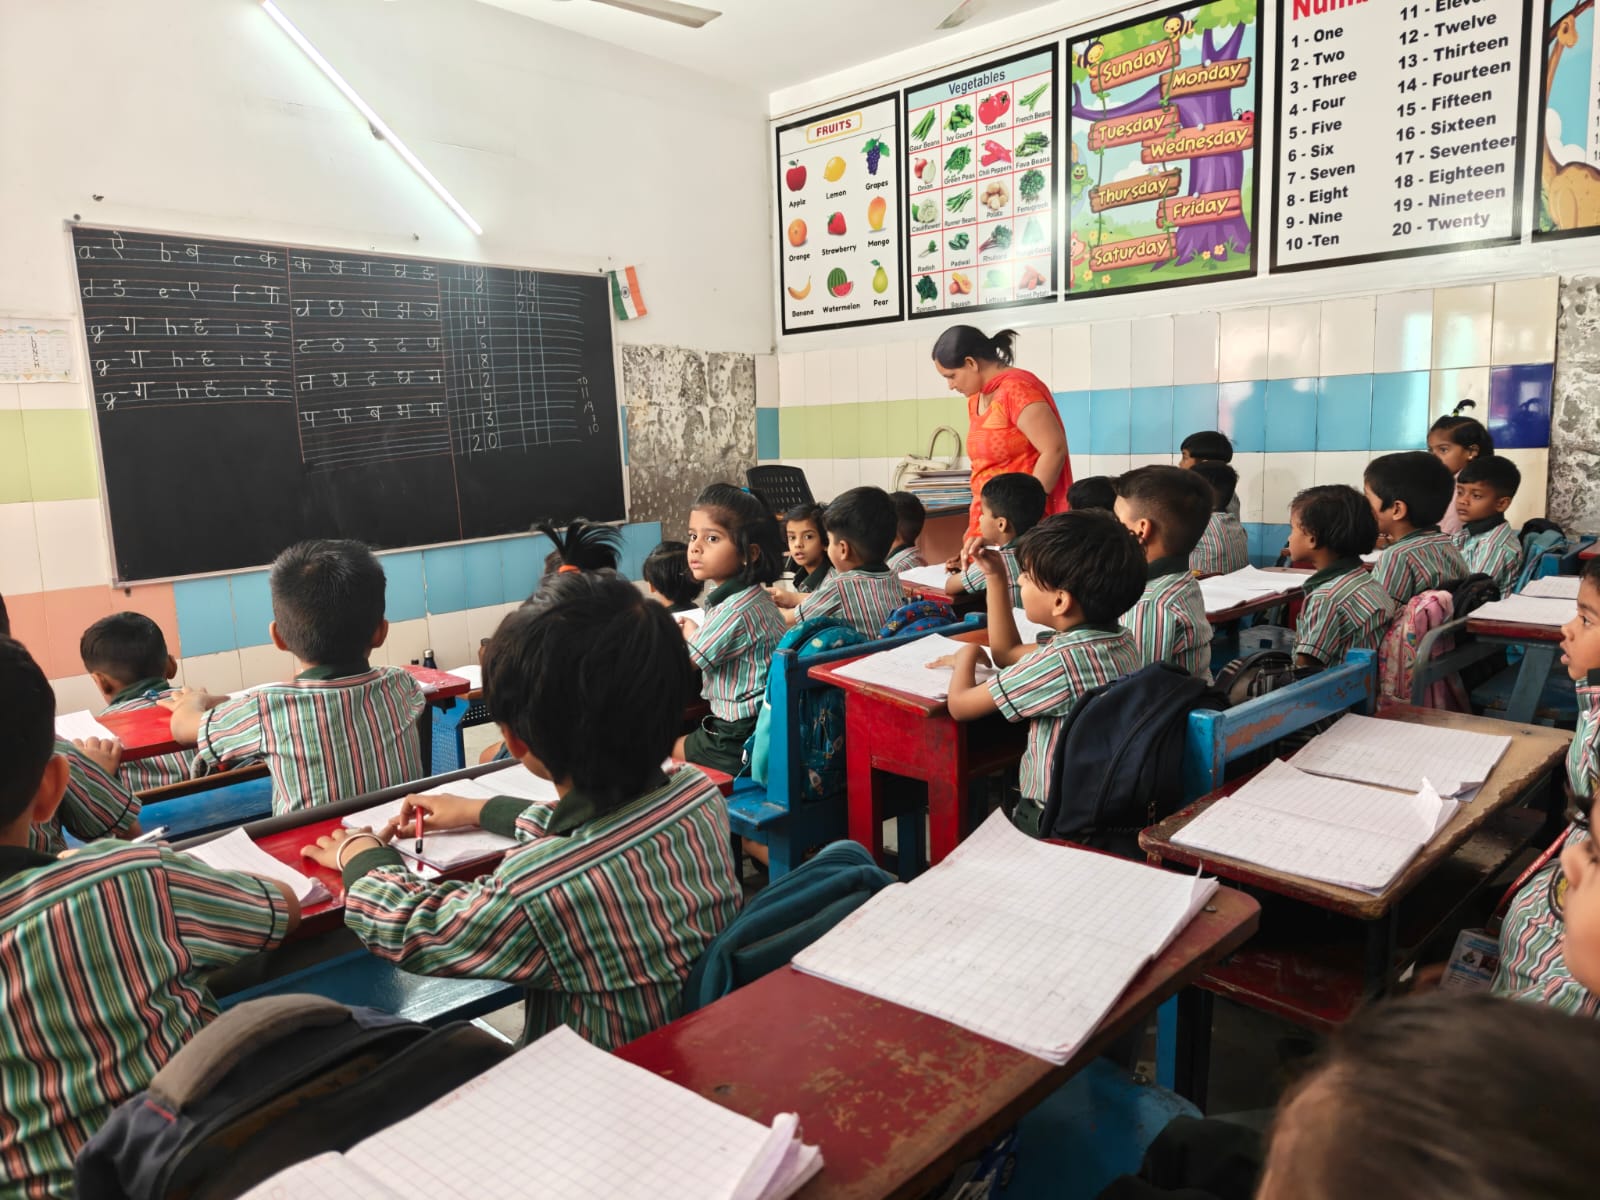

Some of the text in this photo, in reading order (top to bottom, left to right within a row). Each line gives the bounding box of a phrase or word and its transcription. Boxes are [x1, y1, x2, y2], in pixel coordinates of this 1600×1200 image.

[1401, 5, 1417, 20] 11
[1292, 35, 1298, 47] 1
[1314, 28, 1343, 42] One
[1400, 30, 1418, 45] 12
[1435, 14, 1496, 36] Twelve
[1291, 58, 1299, 71] 2
[1313, 51, 1344, 65] Two
[1399, 54, 1417, 69] 13
[1434, 37, 1508, 61] Thirteen
[1103, 45, 1168, 82] Sunday
[949, 71, 1005, 95] Vegetables
[1173, 63, 1242, 87] Monday
[1291, 81, 1298, 94] 3
[1313, 71, 1357, 88] Three
[1398, 78, 1416, 93] 14
[1432, 61, 1510, 86] Fourteen
[1289, 104, 1298, 116] 4
[1313, 97, 1345, 112] Four
[1397, 102, 1416, 117] 15
[1432, 91, 1491, 111] Fifteen
[816, 119, 852, 137] FRUITS
[1099, 114, 1166, 141] Tuesday
[1290, 127, 1297, 139] 5
[1312, 121, 1342, 135] Five
[1397, 127, 1415, 141] 16
[1431, 115, 1496, 135] Sixteen
[1151, 127, 1249, 158] Wednesday
[1288, 150, 1296, 161] 6
[1311, 144, 1333, 157] Six
[1396, 151, 1414, 165] 17
[1288, 172, 1296, 184] 7
[1310, 164, 1355, 180] Seven
[1395, 175, 1413, 188] 18
[1430, 163, 1504, 184] Eighteen
[826, 190, 846, 199] Lemon
[866, 181, 888, 190] Grapes
[1099, 177, 1169, 205] Thursday
[789, 199, 806, 208] Apple
[1287, 195, 1295, 206] 8
[1310, 186, 1348, 203] Eight
[1394, 198, 1412, 212] 19
[1429, 188, 1505, 207] Nineteen
[1173, 197, 1228, 218] Friday
[1287, 217, 1294, 228] 9
[1309, 212, 1342, 225] Nine
[1392, 222, 1411, 236] 20
[1427, 214, 1489, 231] Twenty
[822, 245, 856, 256] Strawberry
[868, 239, 889, 247] Mango
[1095, 239, 1169, 265] Saturday
[1287, 238, 1302, 250] 10
[293, 257, 312, 273] क
[328, 260, 344, 275] ख
[361, 262, 377, 276] ग
[294, 299, 312, 317] च
[361, 301, 381, 318] ज
[823, 303, 860, 313] Watermelon
[297, 339, 314, 353] ट
[328, 338, 345, 352] ठ
[364, 338, 380, 352] ड
[426, 337, 440, 352] ण
[468, 354, 489, 369] 18
[298, 375, 315, 391] त
[331, 372, 347, 387] थ
[469, 372, 490, 388] 12
[300, 411, 320, 428] प
[333, 408, 351, 424] फ
[366, 406, 382, 421] ब
[426, 403, 443, 417] म
[472, 411, 494, 428] 13
[473, 432, 497, 451] 20
